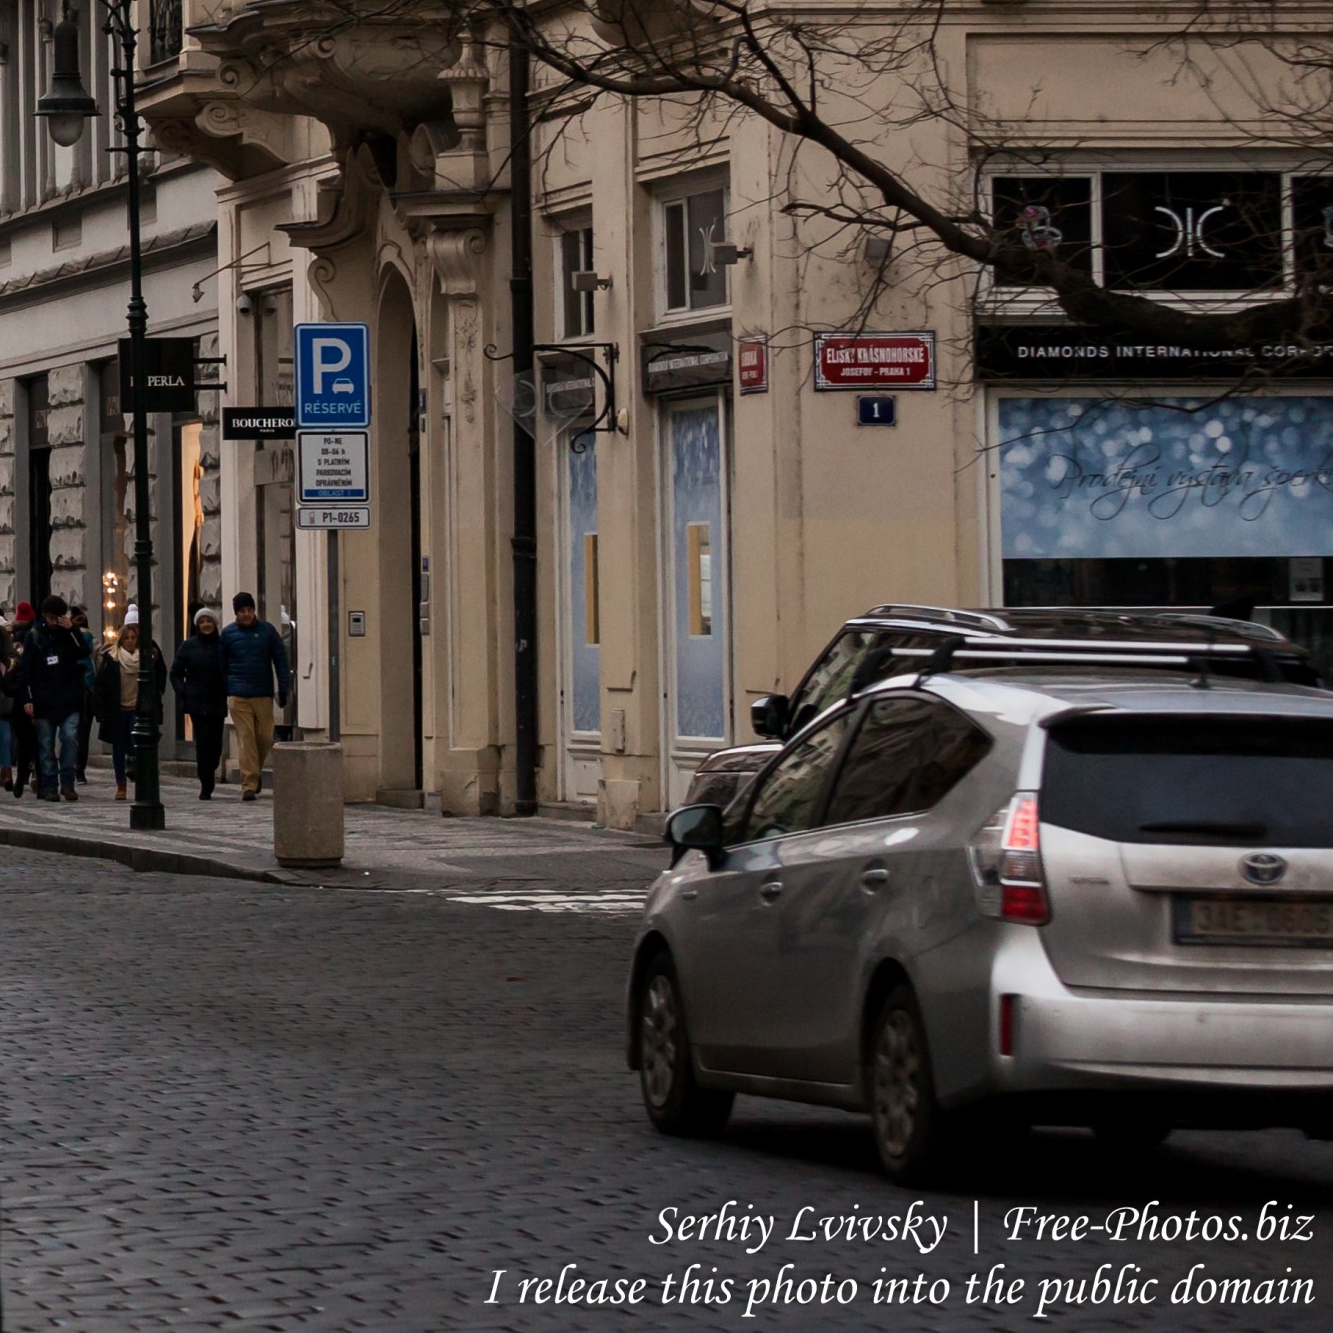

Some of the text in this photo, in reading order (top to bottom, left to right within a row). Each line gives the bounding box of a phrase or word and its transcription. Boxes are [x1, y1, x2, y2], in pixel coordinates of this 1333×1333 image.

[857, 344, 924, 364] KRÁSNOHORSKÉ
[1017, 346, 1109, 358] DIAMONDS
[312, 338, 352, 394] P
[840, 368, 873, 376] JOSEFOV
[879, 367, 904, 376] PRAHA
[147, 375, 185, 387] PERLA
[304, 400, 362, 414] RÉSERVÉ
[873, 402, 880, 418] 1
[233, 418, 295, 428] BOUCHERO
[322, 512, 360, 523] P1-0265
